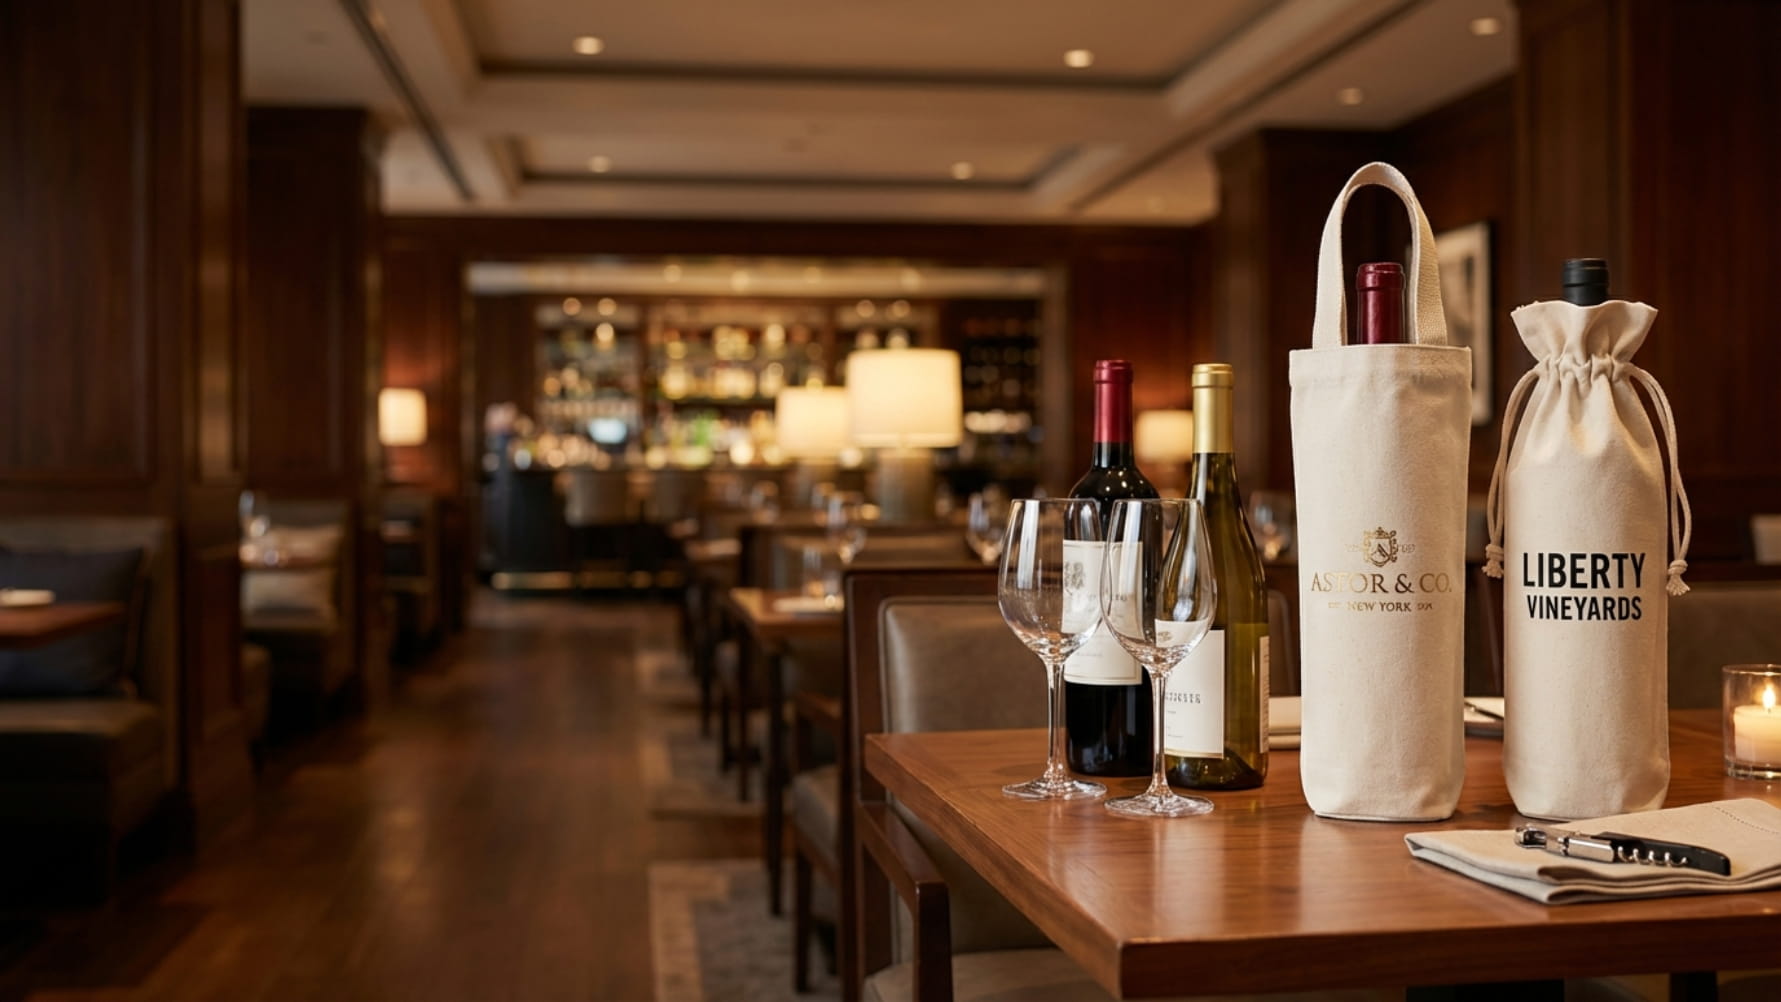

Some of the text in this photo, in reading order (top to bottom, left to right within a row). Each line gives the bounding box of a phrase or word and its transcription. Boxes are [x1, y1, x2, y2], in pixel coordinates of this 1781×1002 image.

[1523, 552, 1646, 589] LIBERTY
[1311, 572, 1452, 593] ASTOR & CO.
[1348, 601, 1376, 612] NEW
[1379, 601, 1412, 612] YORK
[1527, 595, 1642, 621] VINEYARDS
